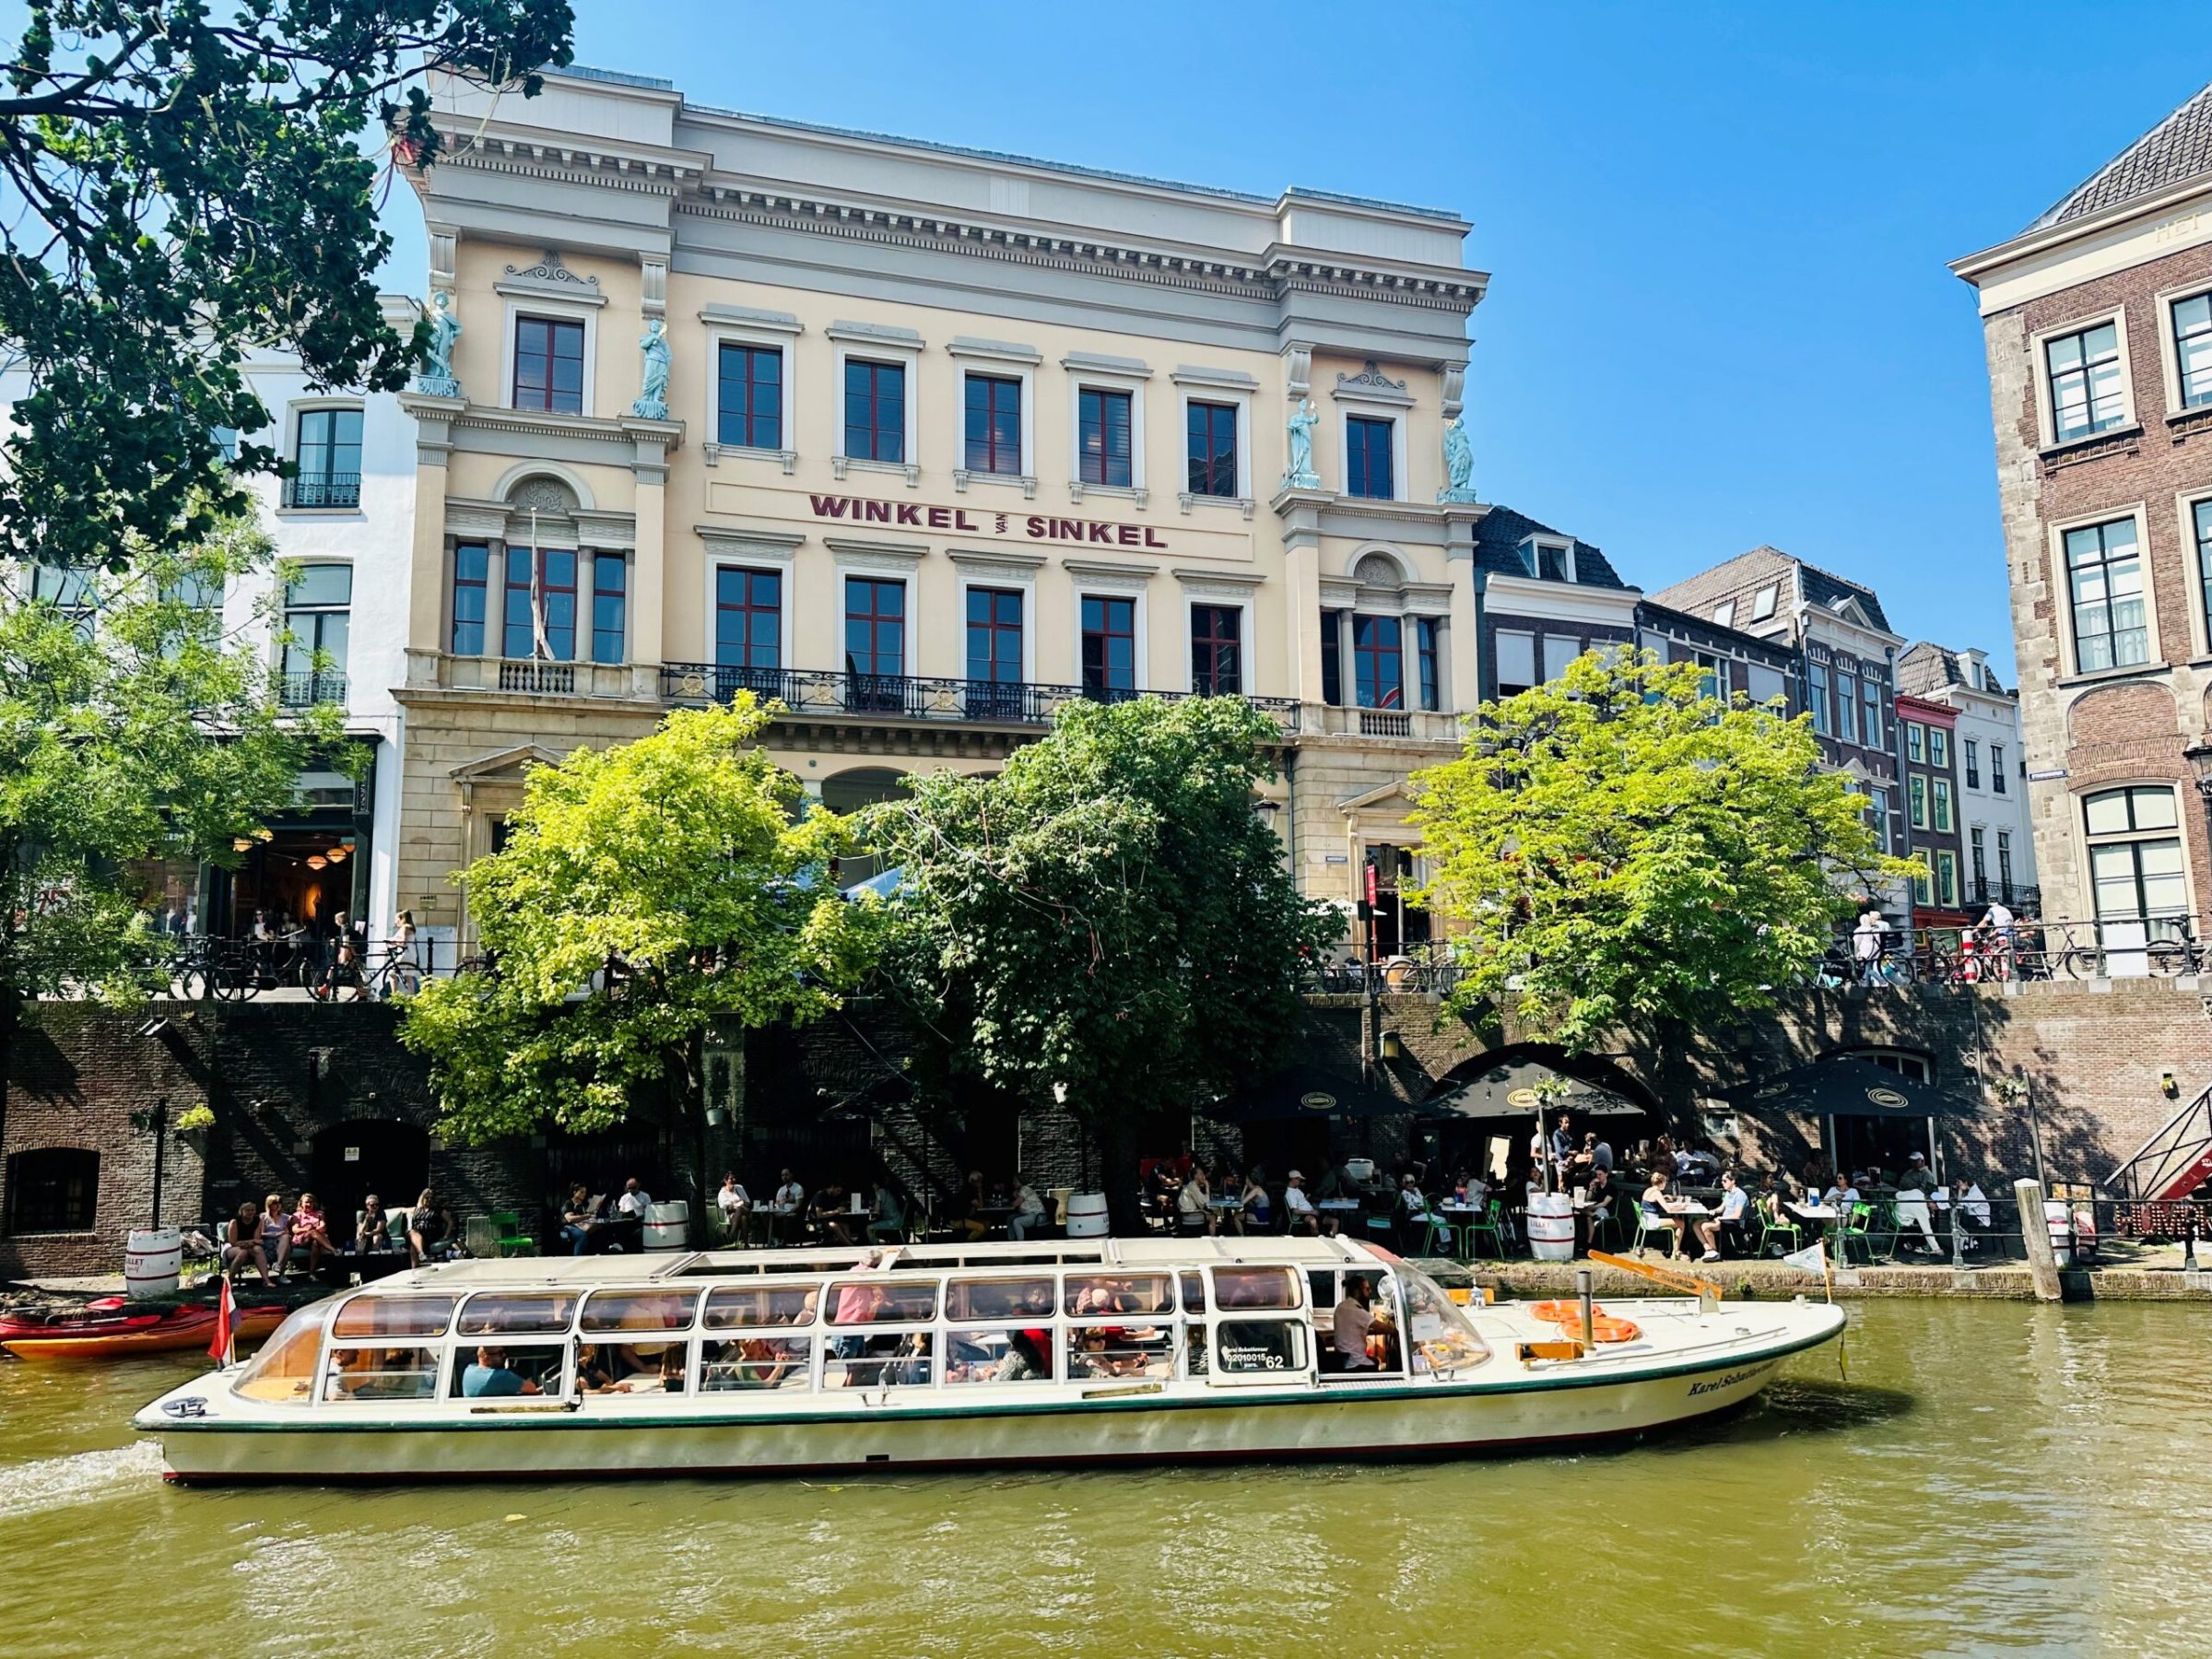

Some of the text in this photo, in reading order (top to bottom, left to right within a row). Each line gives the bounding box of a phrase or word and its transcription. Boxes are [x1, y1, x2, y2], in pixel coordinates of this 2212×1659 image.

[809, 495, 1169, 548] WINKEL VAN SINKEL
[1227, 1353, 1266, 1362] 02010015
[1265, 1355, 1285, 1370] 62
[1687, 1378, 1723, 1396] Karel
